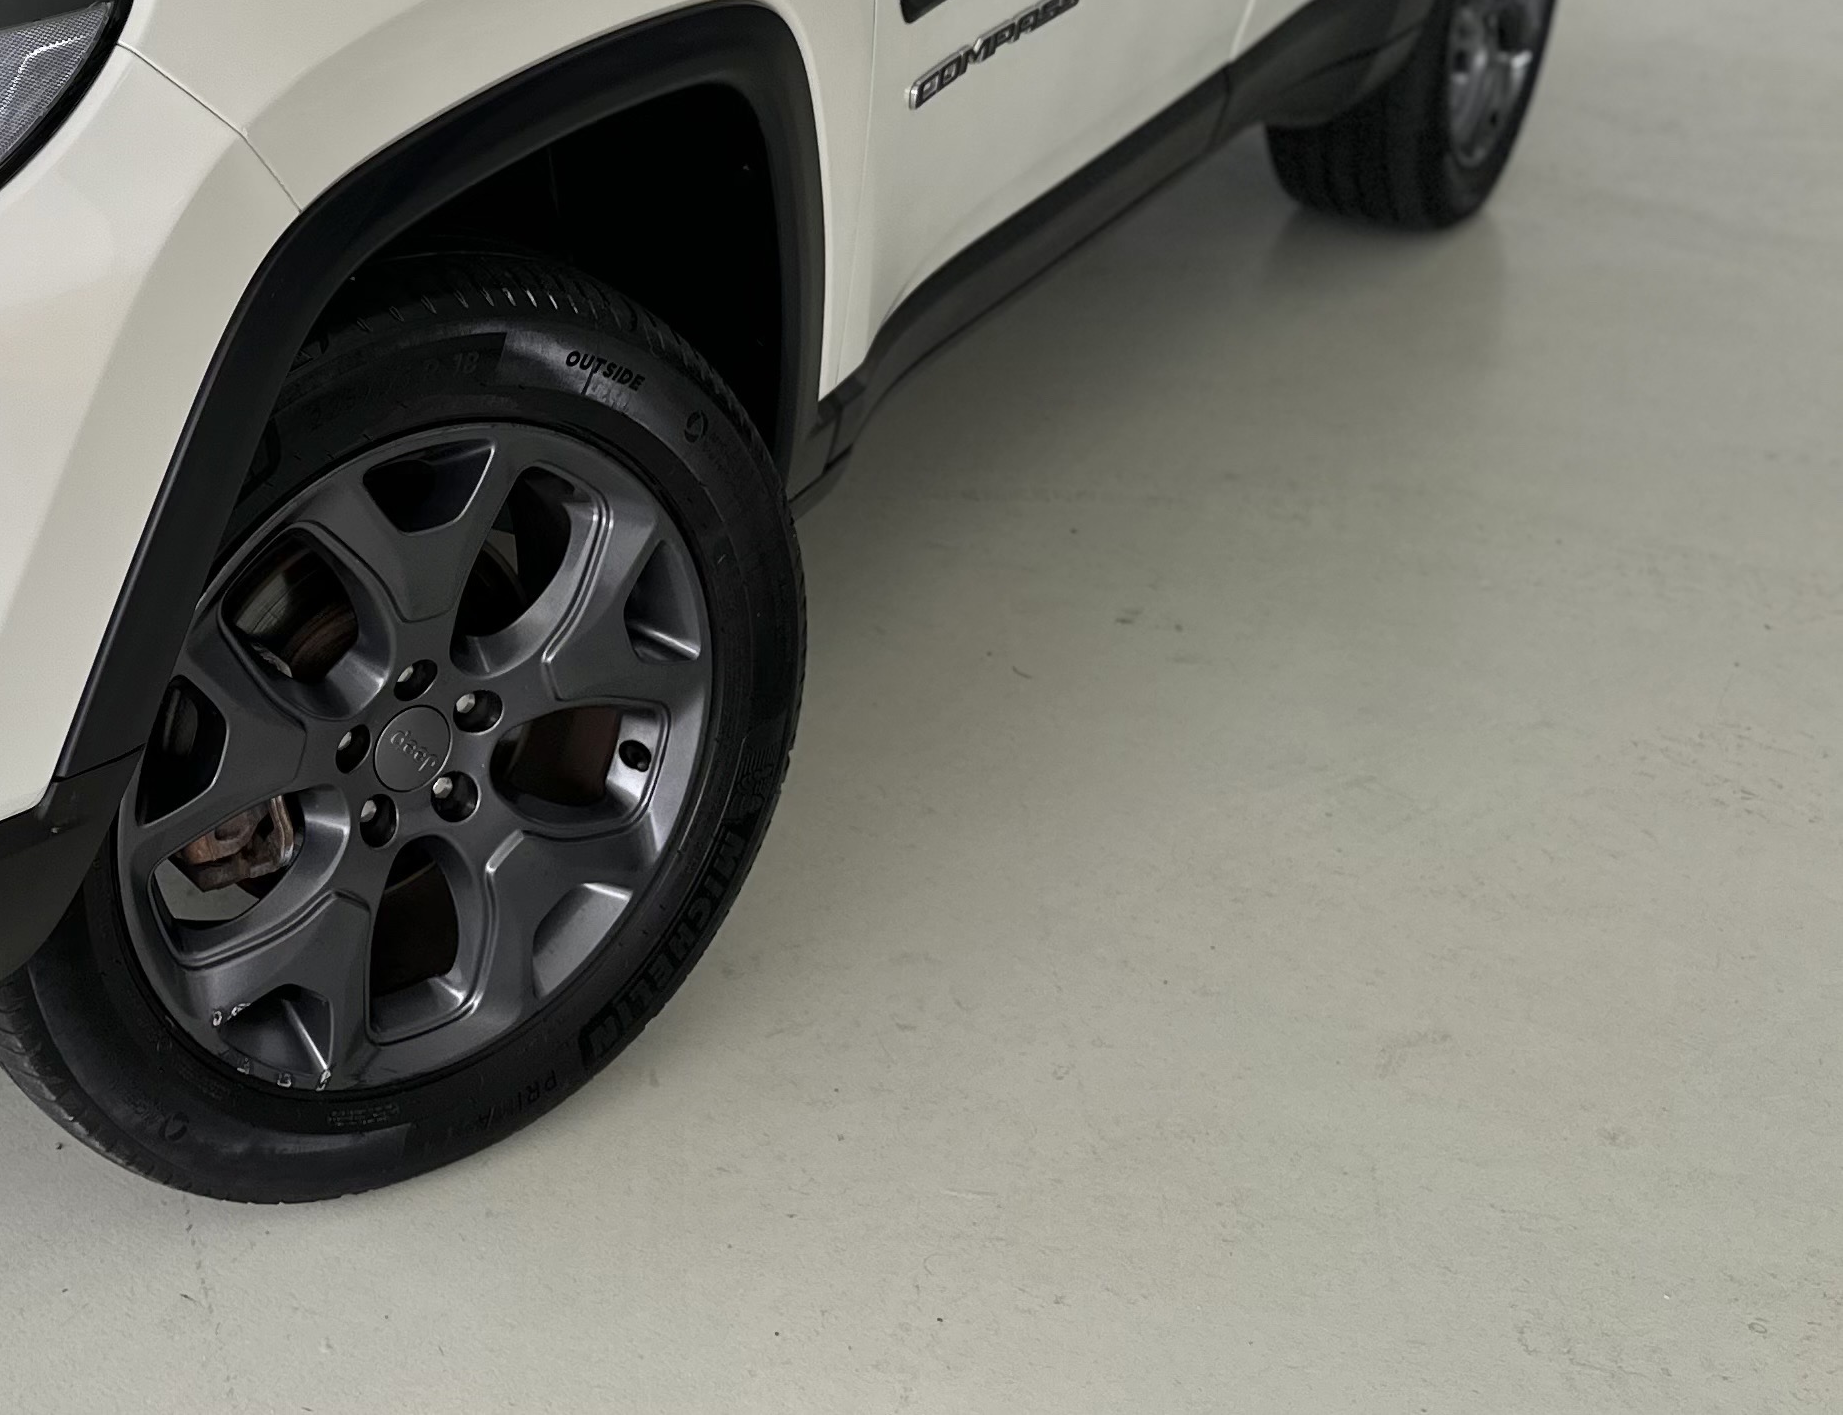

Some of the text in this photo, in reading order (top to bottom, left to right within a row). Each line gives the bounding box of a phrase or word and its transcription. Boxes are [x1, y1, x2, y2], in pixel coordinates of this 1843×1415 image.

[565, 350, 646, 392] OUTSIDE
[390, 730, 439, 773] Jeep
[585, 830, 749, 1062] MICHELIN
